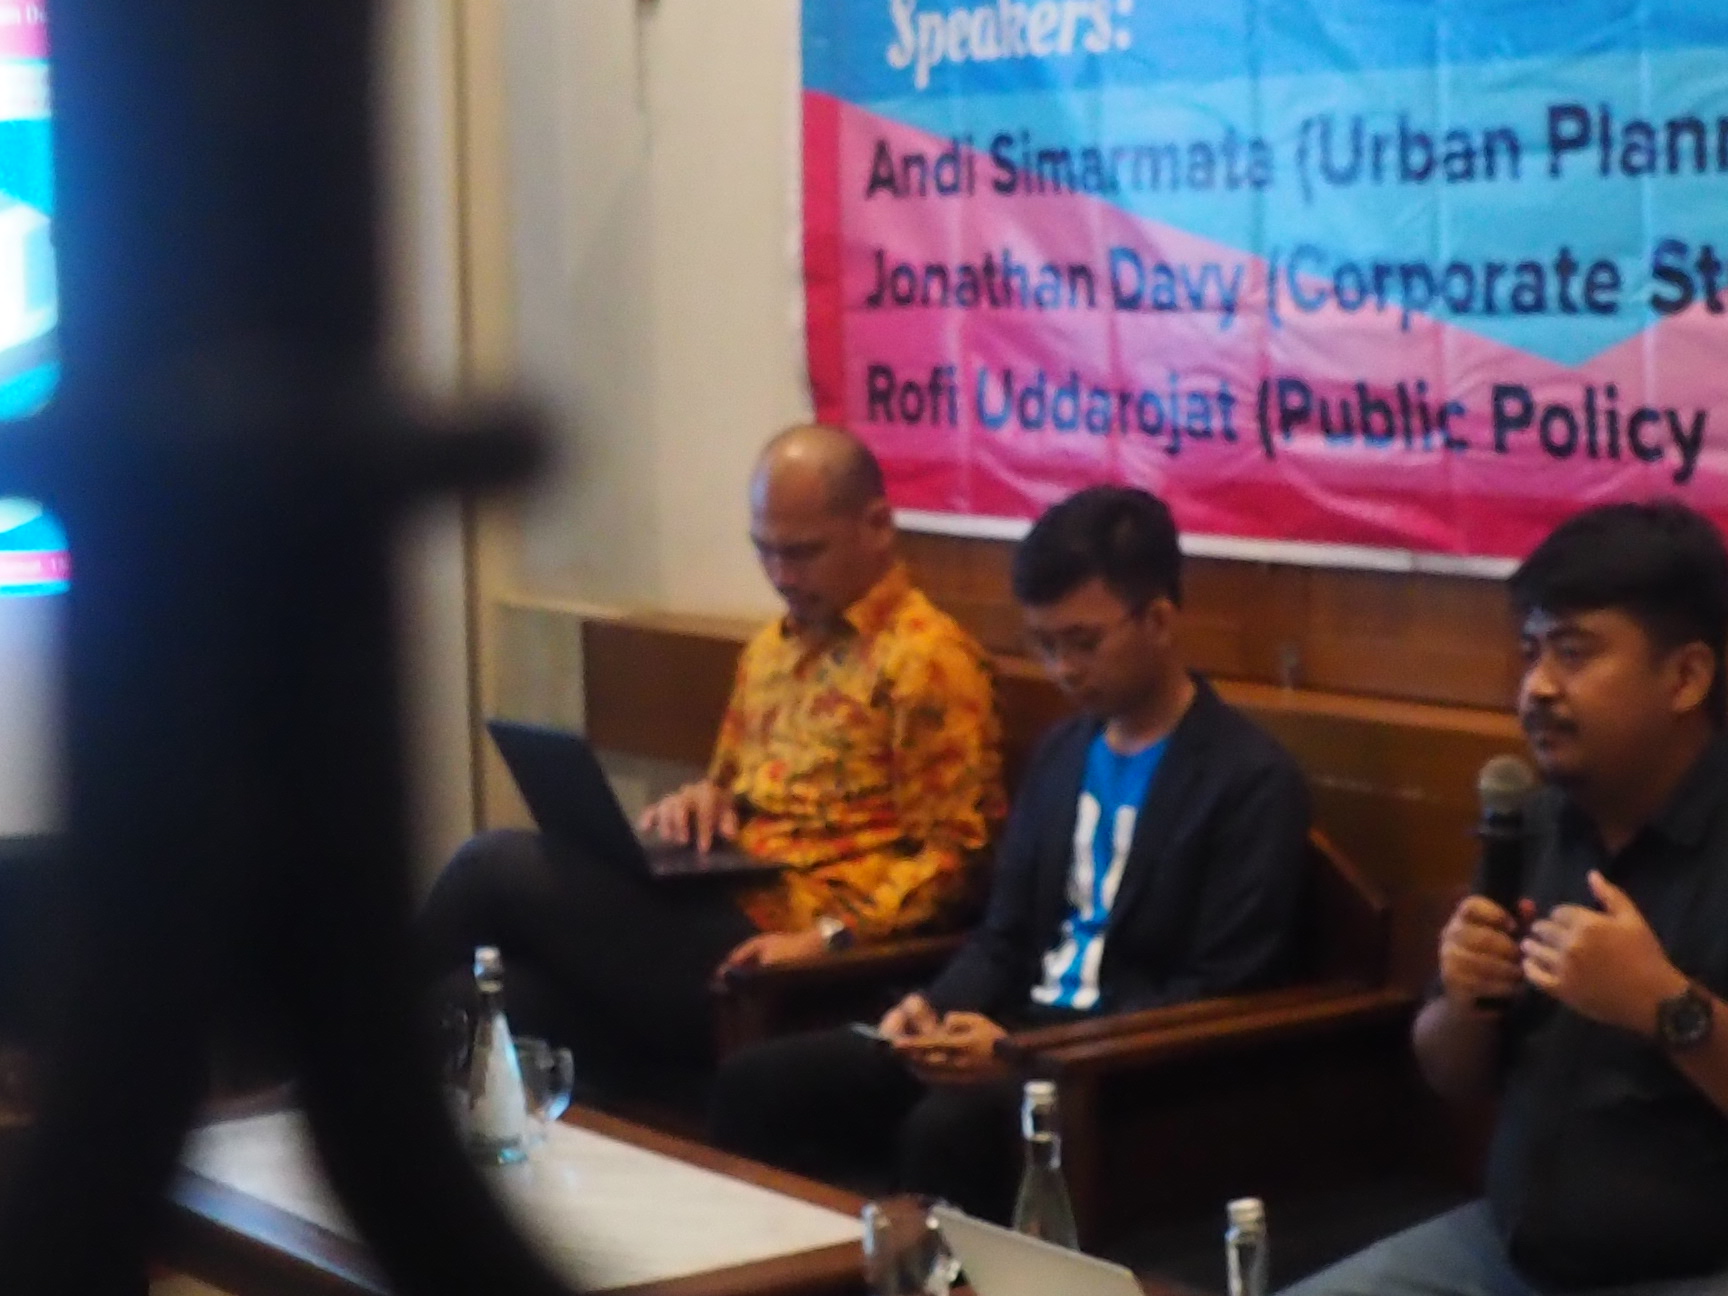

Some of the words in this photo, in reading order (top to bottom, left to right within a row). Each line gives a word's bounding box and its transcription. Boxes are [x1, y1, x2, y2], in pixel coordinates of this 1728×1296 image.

[865, 133, 976, 201] Andi
[990, 124, 1273, 198] Simarmata
[1295, 112, 1522, 204] (Urban
[865, 247, 1096, 312] Jonathan
[1108, 244, 1244, 331] Davy
[1266, 241, 1622, 332] (Corporate
[866, 362, 959, 426] Rofi
[976, 366, 1239, 456] Uddarojat
[1256, 376, 1470, 461] (Public
[1491, 381, 1708, 485] Policy
